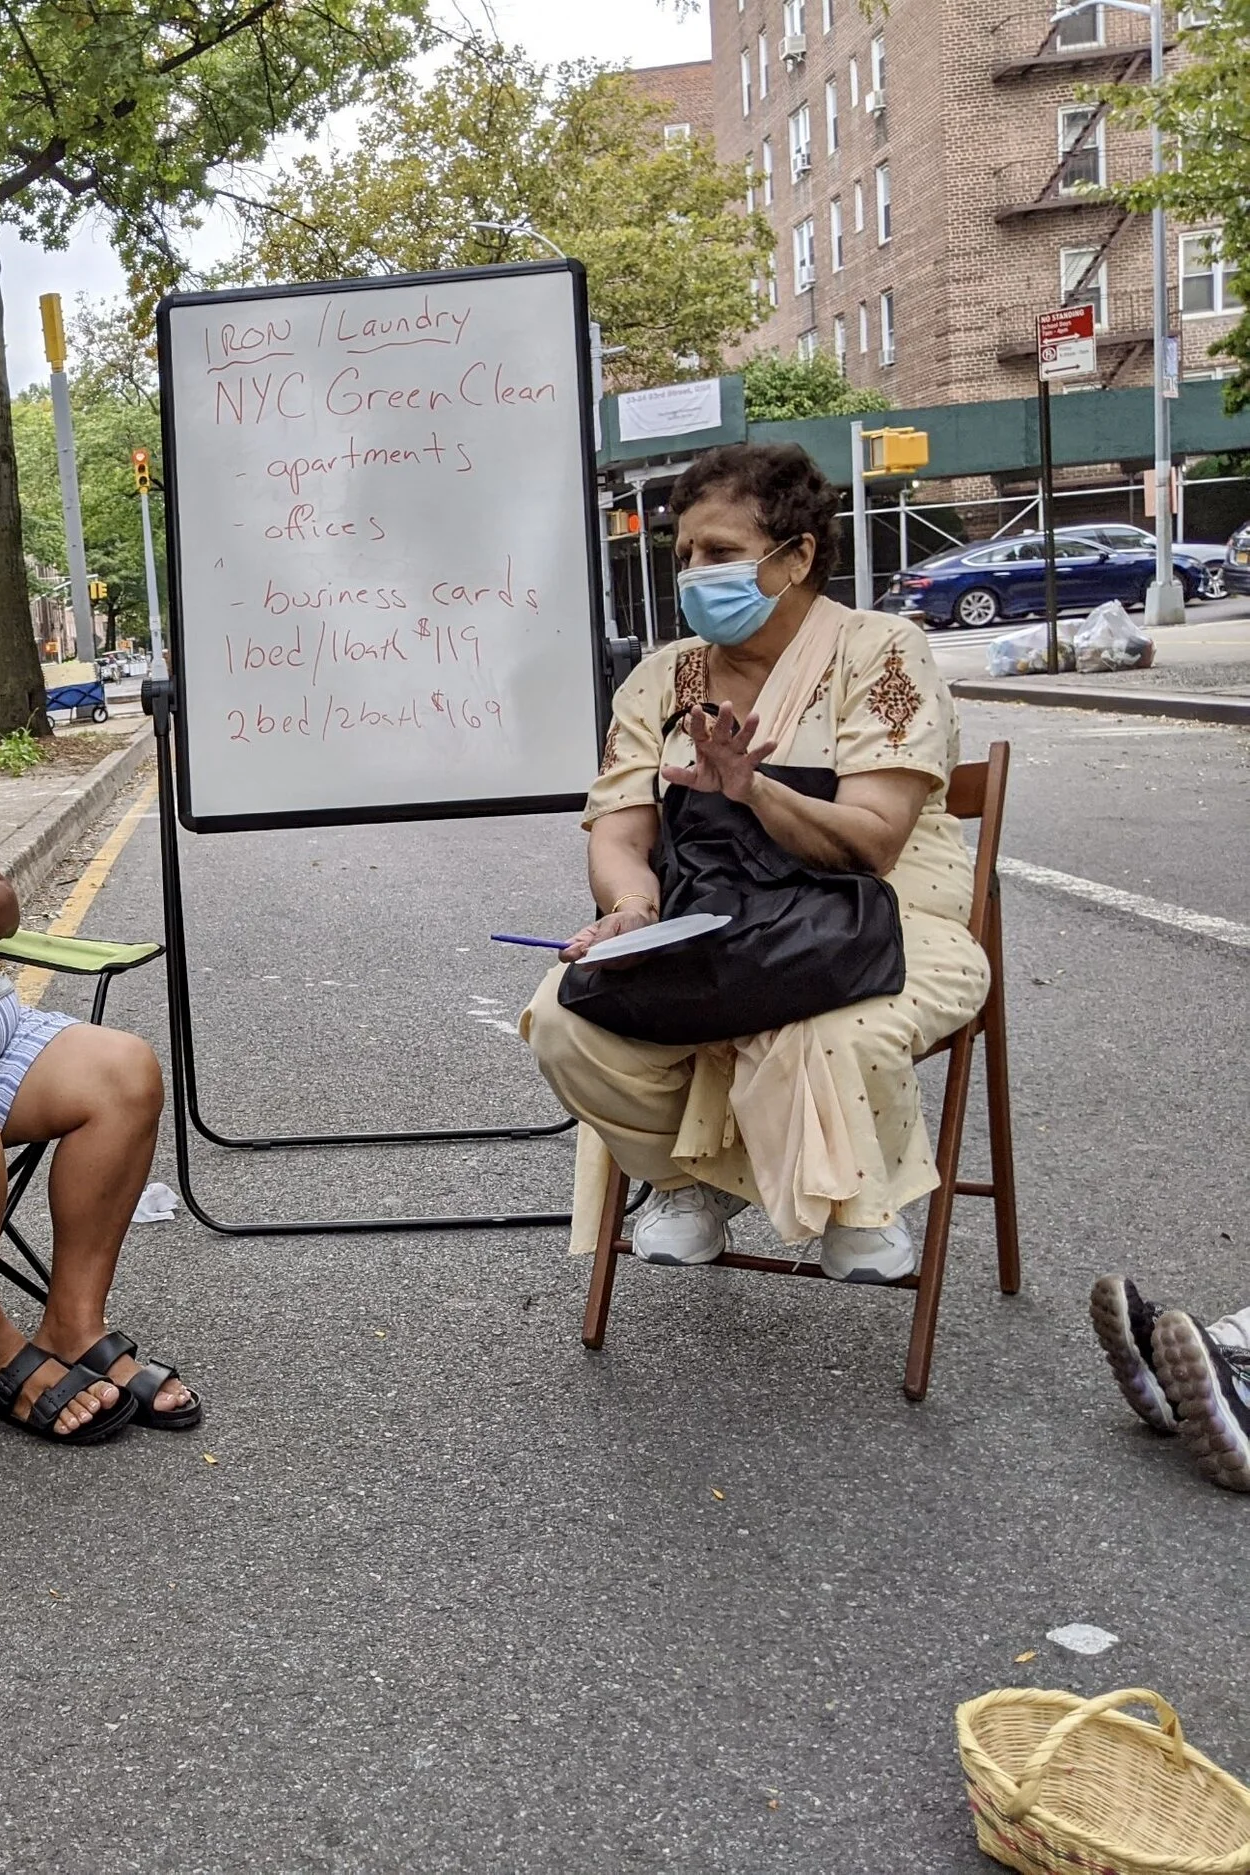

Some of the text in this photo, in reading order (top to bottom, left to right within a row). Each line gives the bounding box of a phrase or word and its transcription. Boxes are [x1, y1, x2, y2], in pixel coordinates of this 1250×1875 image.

[1040, 309, 1084, 323] NO STANDING
[205, 319, 292, 364] IRON
[216, 372, 306, 425] NYC
[267, 433, 473, 495] apartments
[265, 504, 386, 541] offices
[263, 580, 407, 616] business
[432, 554, 539, 610] cards
